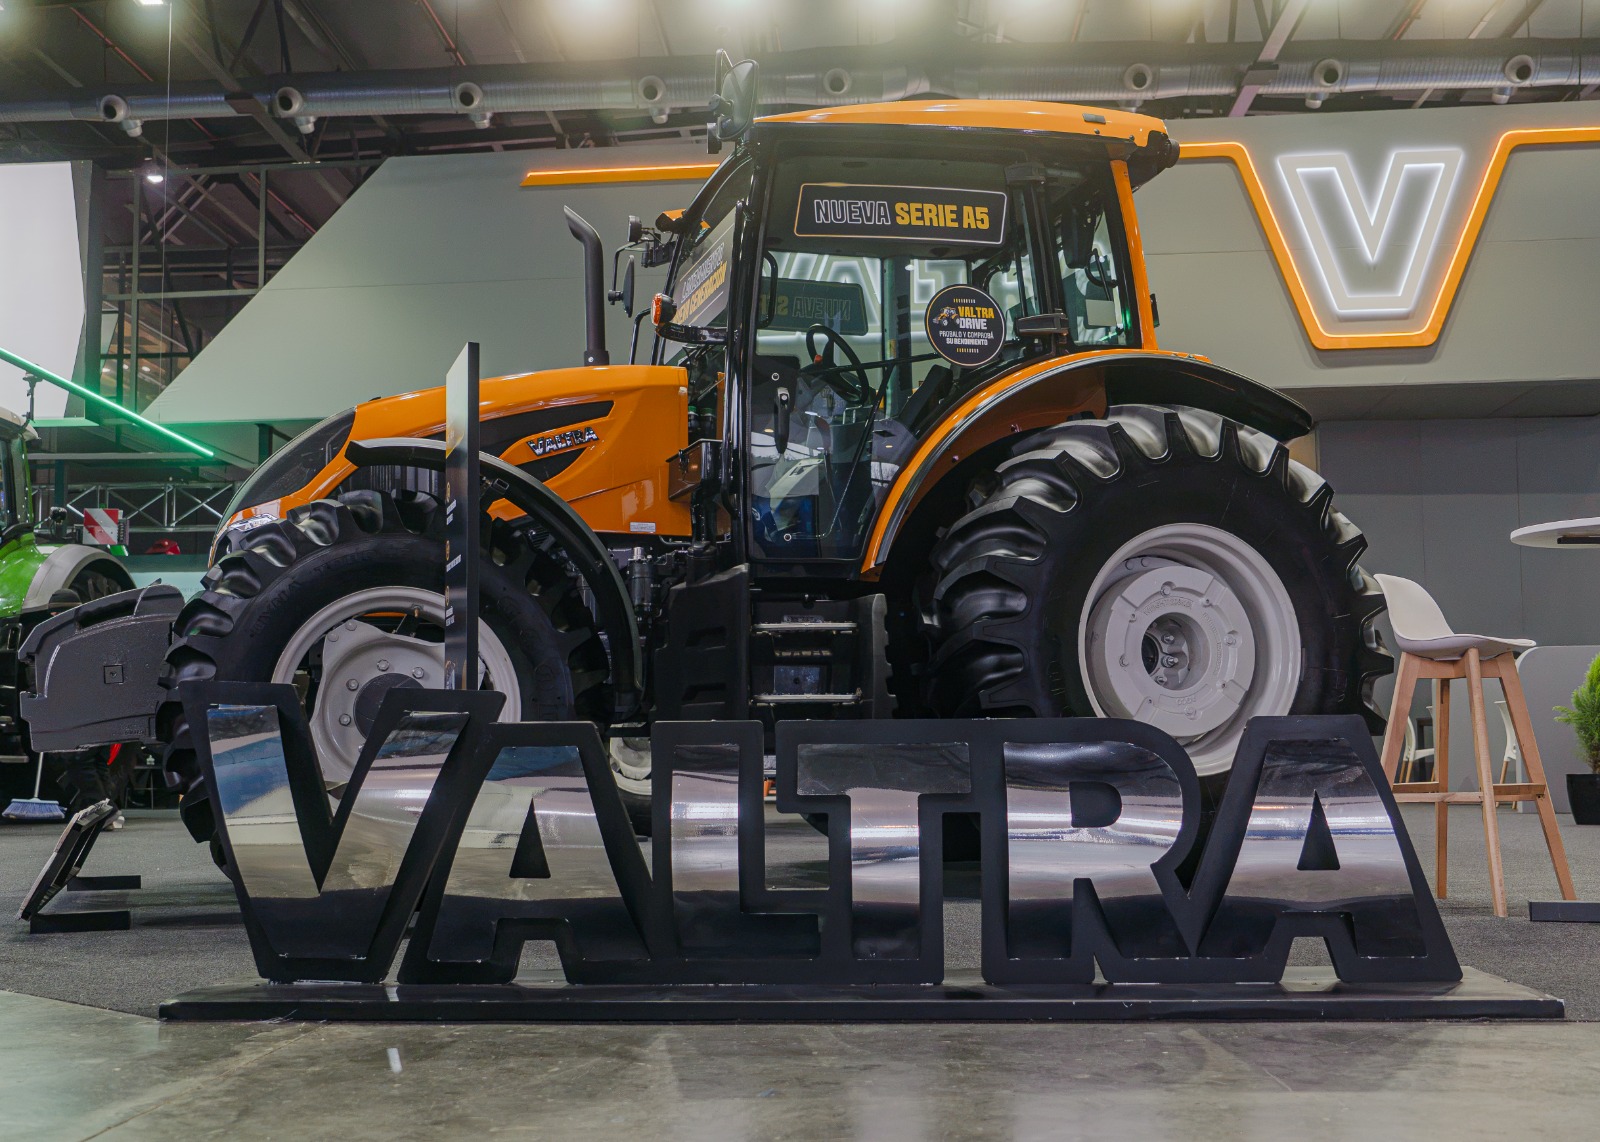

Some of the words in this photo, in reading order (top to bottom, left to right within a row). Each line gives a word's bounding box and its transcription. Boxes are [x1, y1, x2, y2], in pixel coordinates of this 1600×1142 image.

[814, 200, 891, 224] NUEVA
[895, 202, 959, 228] SERIE
[962, 206, 990, 229] A5
[958, 306, 995, 319] VALTRA
[959, 318, 987, 330] DRIVE
[954, 338, 988, 346] RENDIMIENTO
[526, 427, 600, 457] VALTRA
[184, 681, 1464, 985] VALTRA
